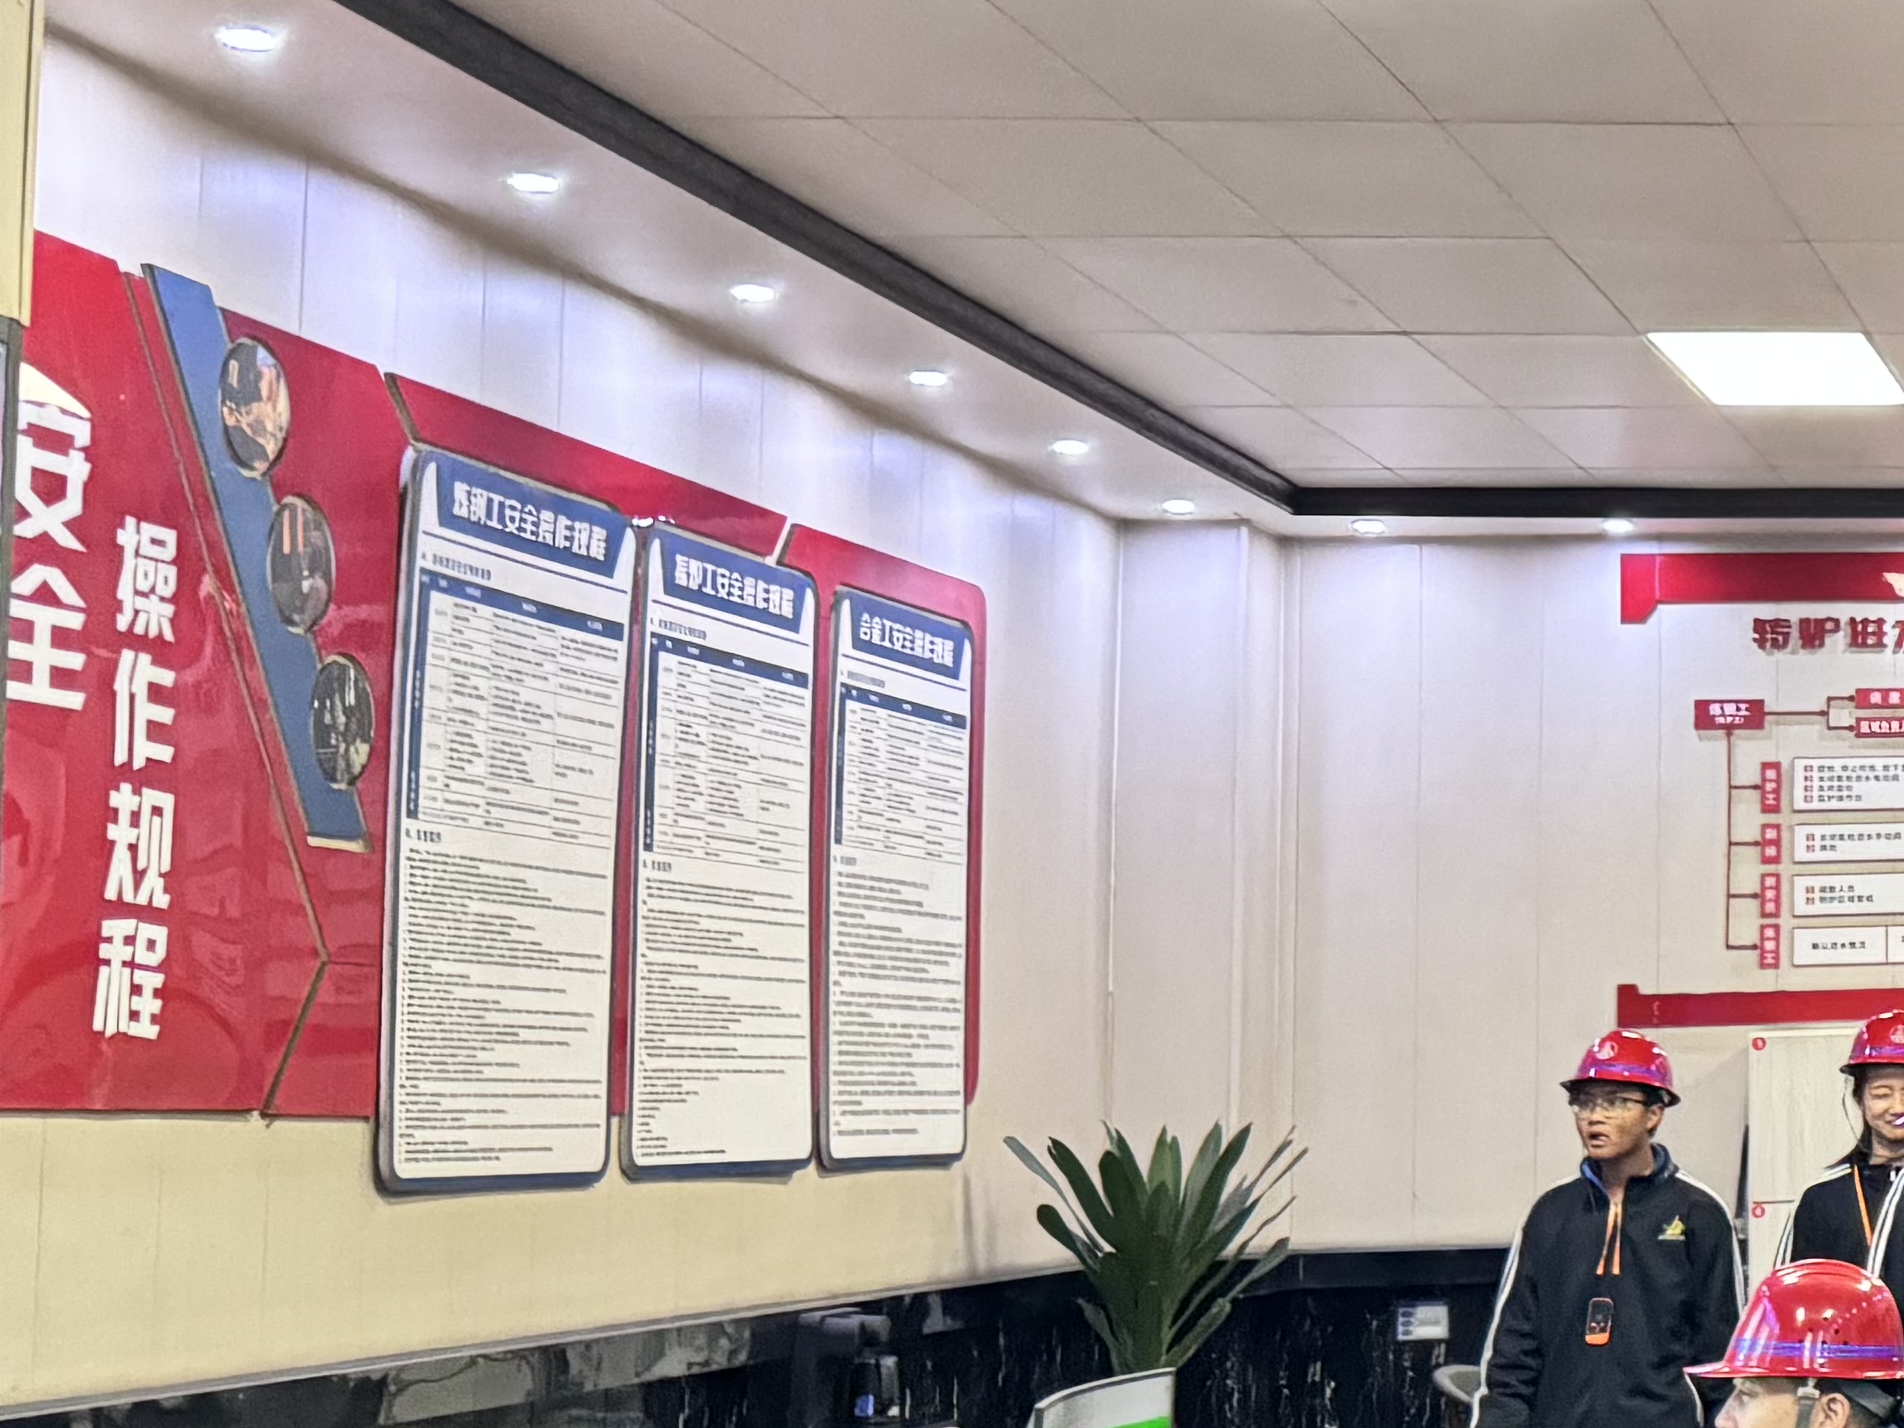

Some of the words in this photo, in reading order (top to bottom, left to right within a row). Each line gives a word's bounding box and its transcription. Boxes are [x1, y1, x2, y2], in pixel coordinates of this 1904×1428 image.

[6, 362, 91, 711] 安全
[92, 515, 178, 1042] 操作规程
